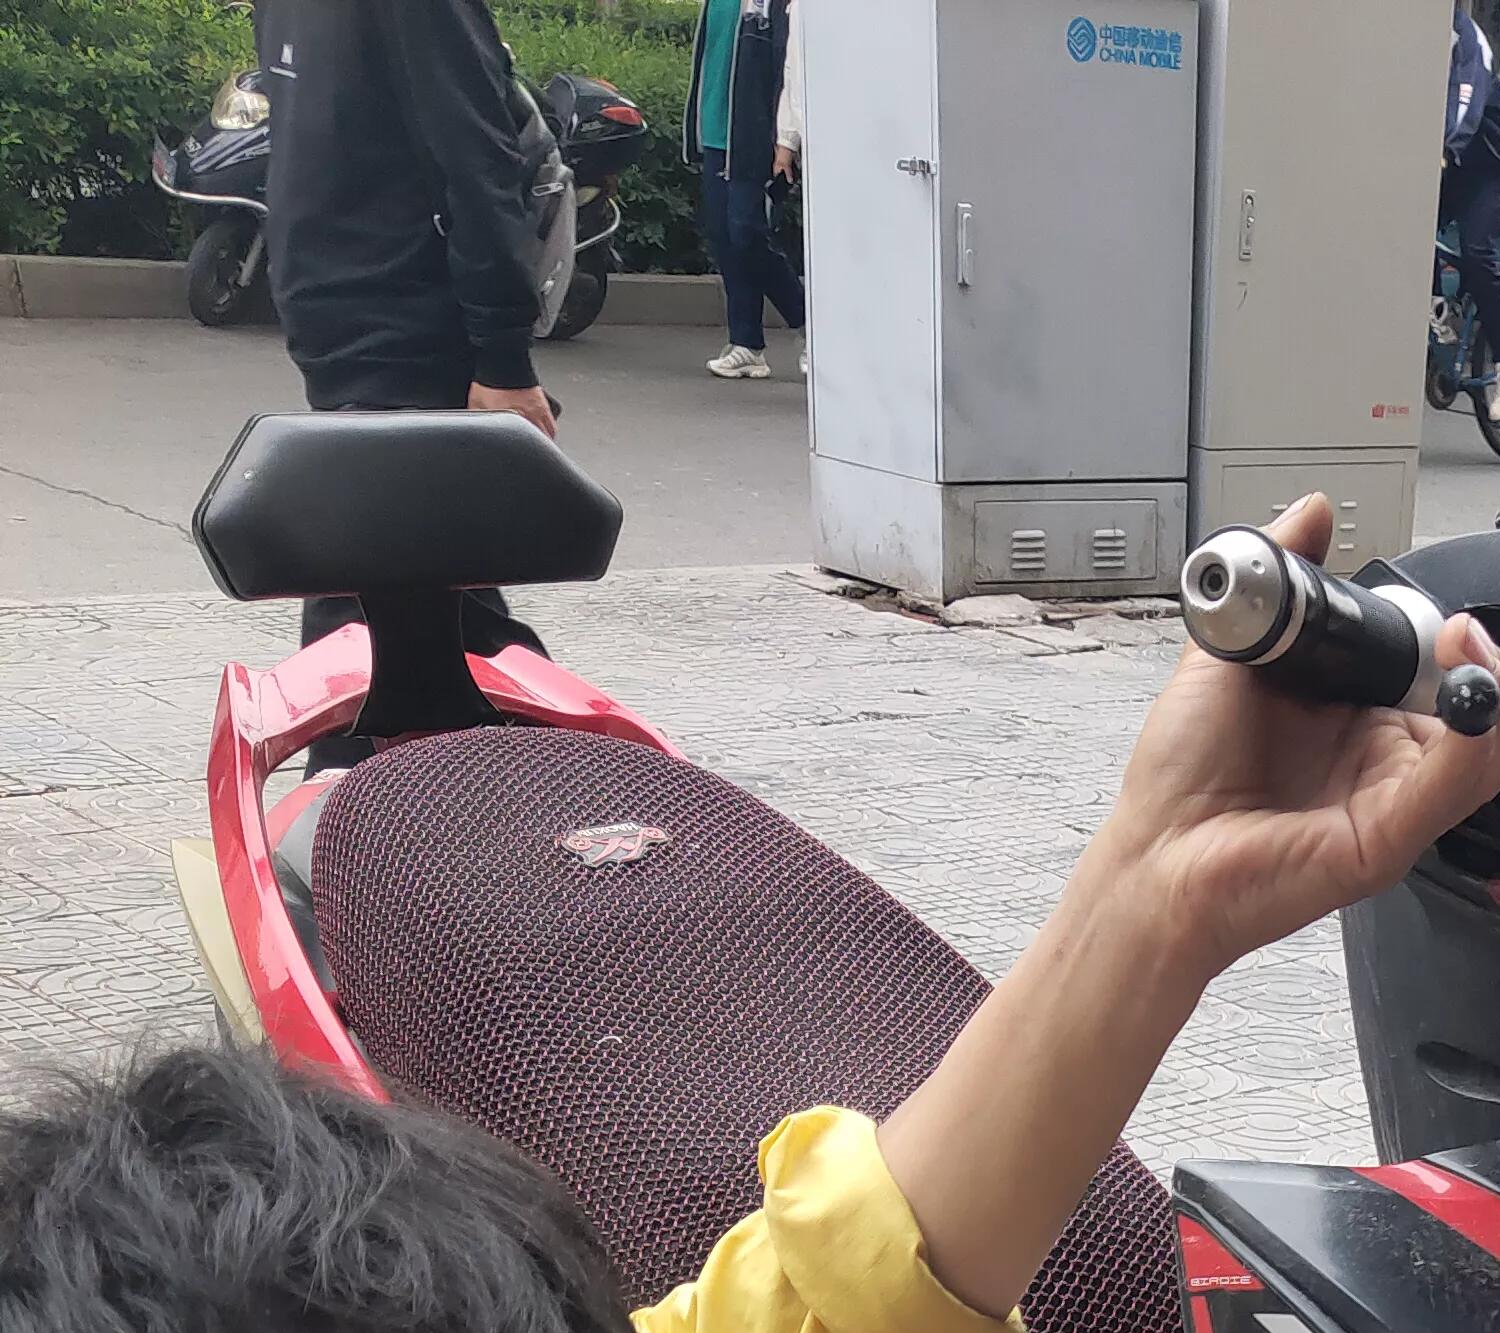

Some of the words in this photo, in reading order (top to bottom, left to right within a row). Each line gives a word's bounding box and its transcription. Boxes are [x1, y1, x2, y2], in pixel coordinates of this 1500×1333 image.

[1100, 23, 1183, 54] 中国移动通信
[1100, 47, 1137, 65] CHINA
